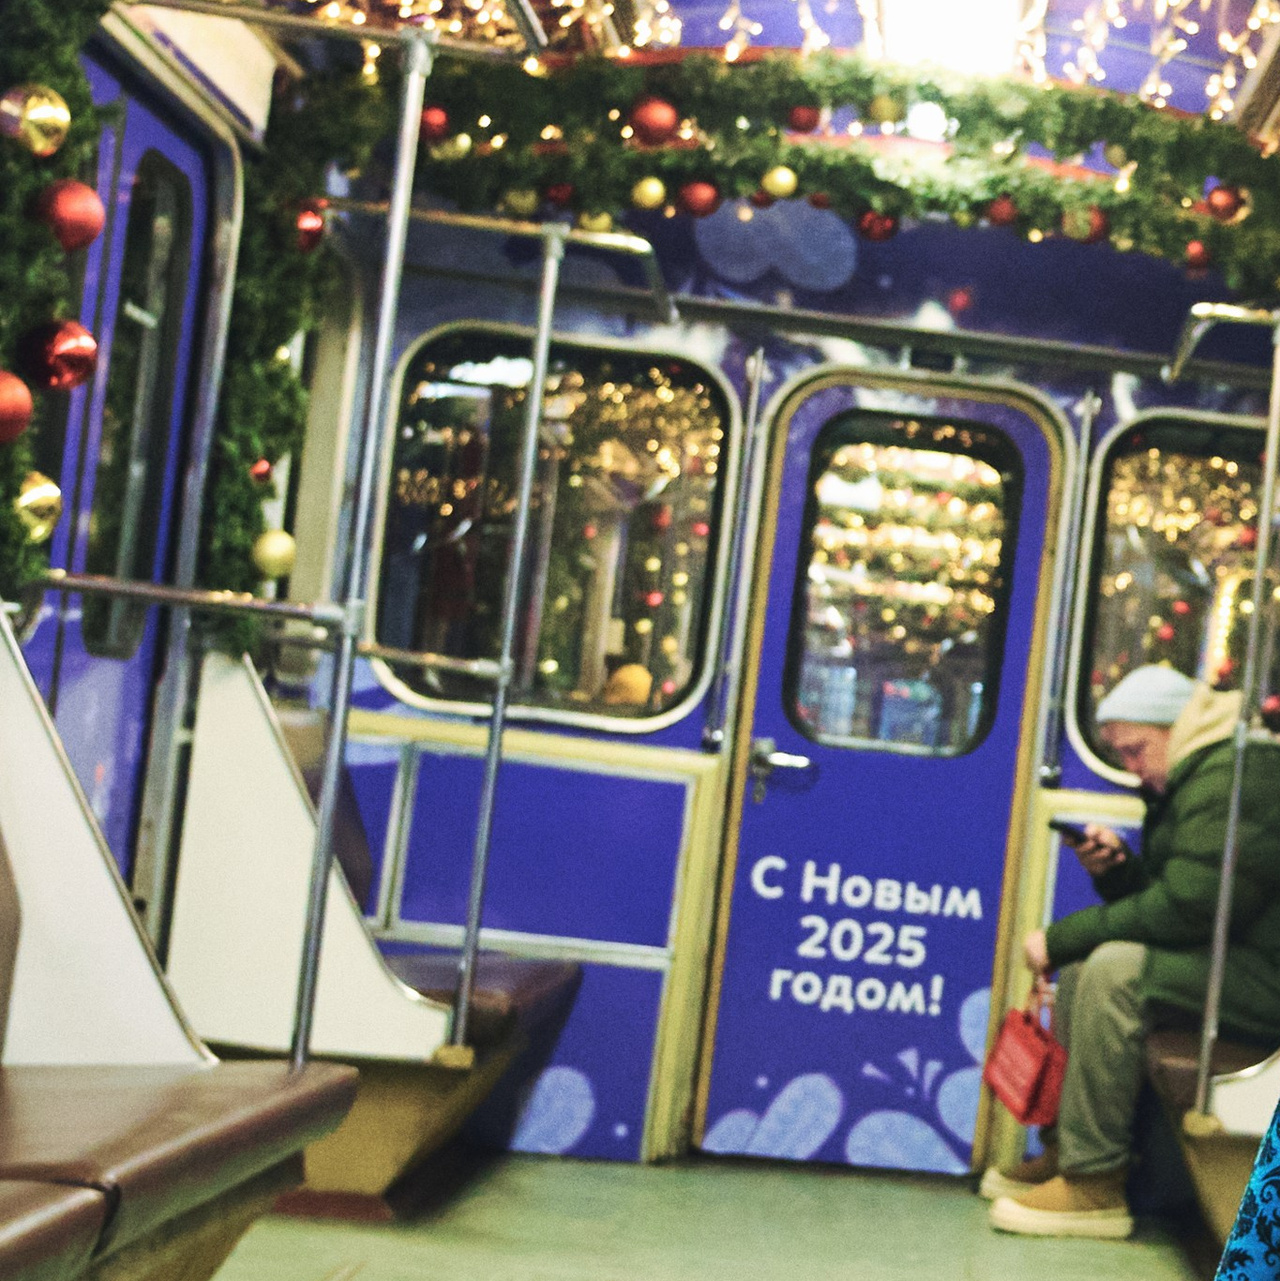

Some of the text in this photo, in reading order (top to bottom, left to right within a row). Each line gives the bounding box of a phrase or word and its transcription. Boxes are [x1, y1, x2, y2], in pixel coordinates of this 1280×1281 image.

[750, 856, 983, 920] С Новым
[797, 915, 927, 968] 2025
[769, 969, 944, 1016] годом!
